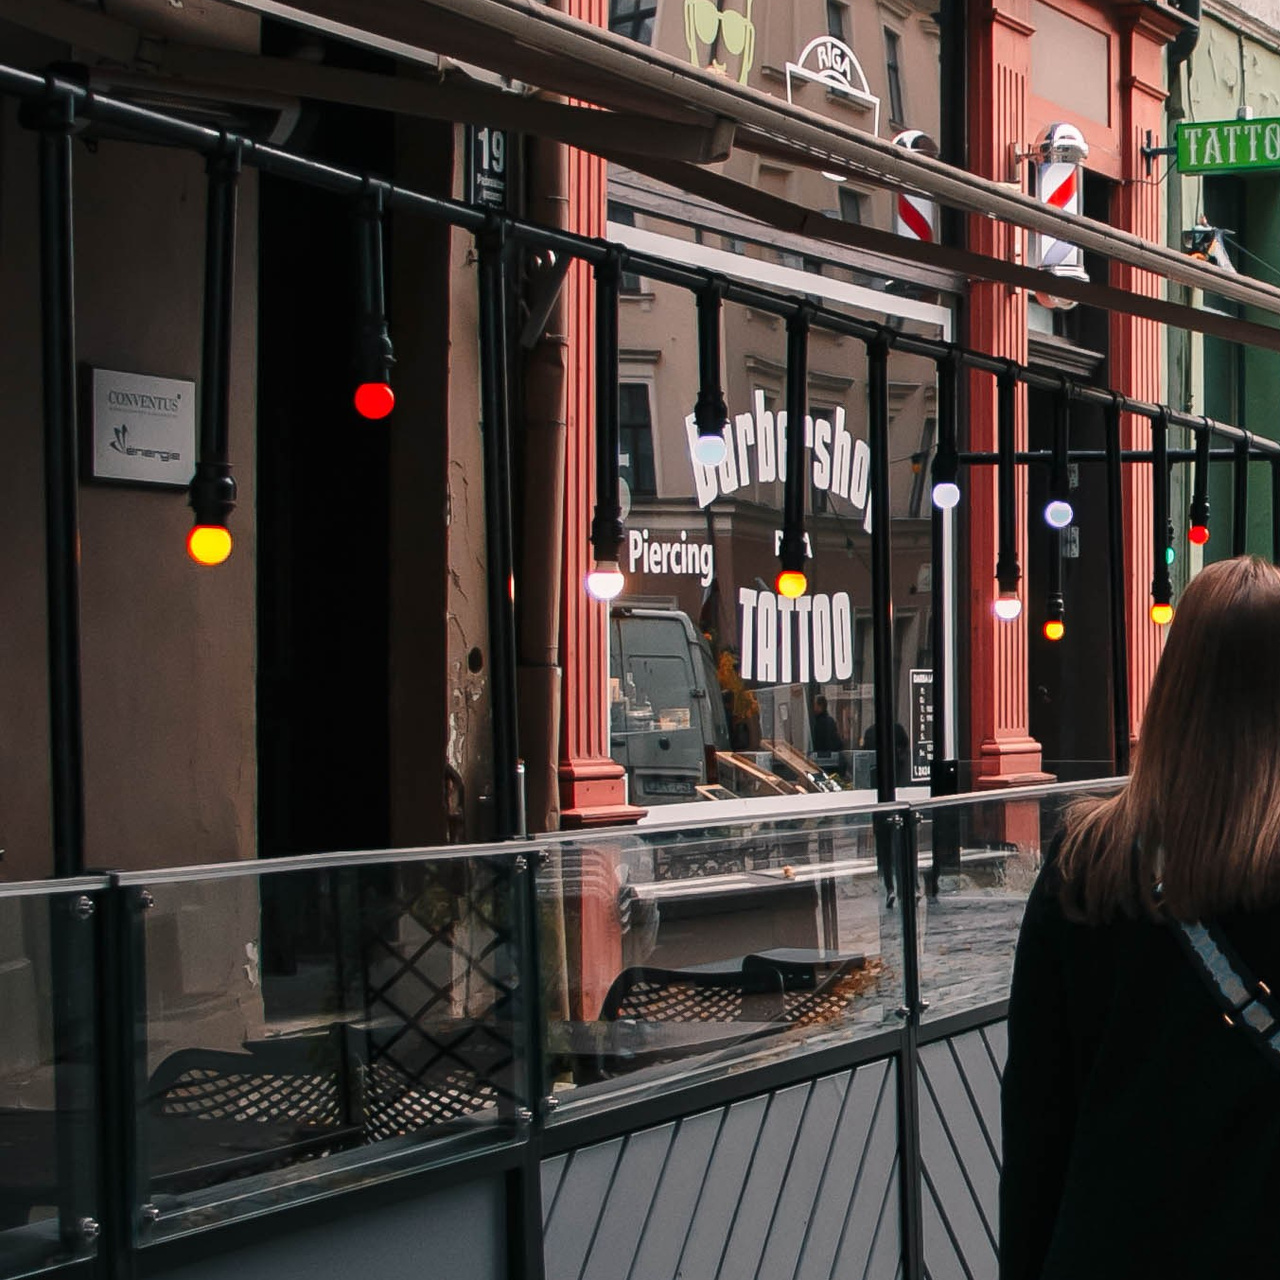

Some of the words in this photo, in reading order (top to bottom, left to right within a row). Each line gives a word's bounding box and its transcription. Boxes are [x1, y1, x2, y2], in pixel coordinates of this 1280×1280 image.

[816, 41, 852, 82] RIGA
[477, 127, 505, 173] 19
[628, 528, 714, 588] Piercing
[739, 586, 853, 684] TATTOO
